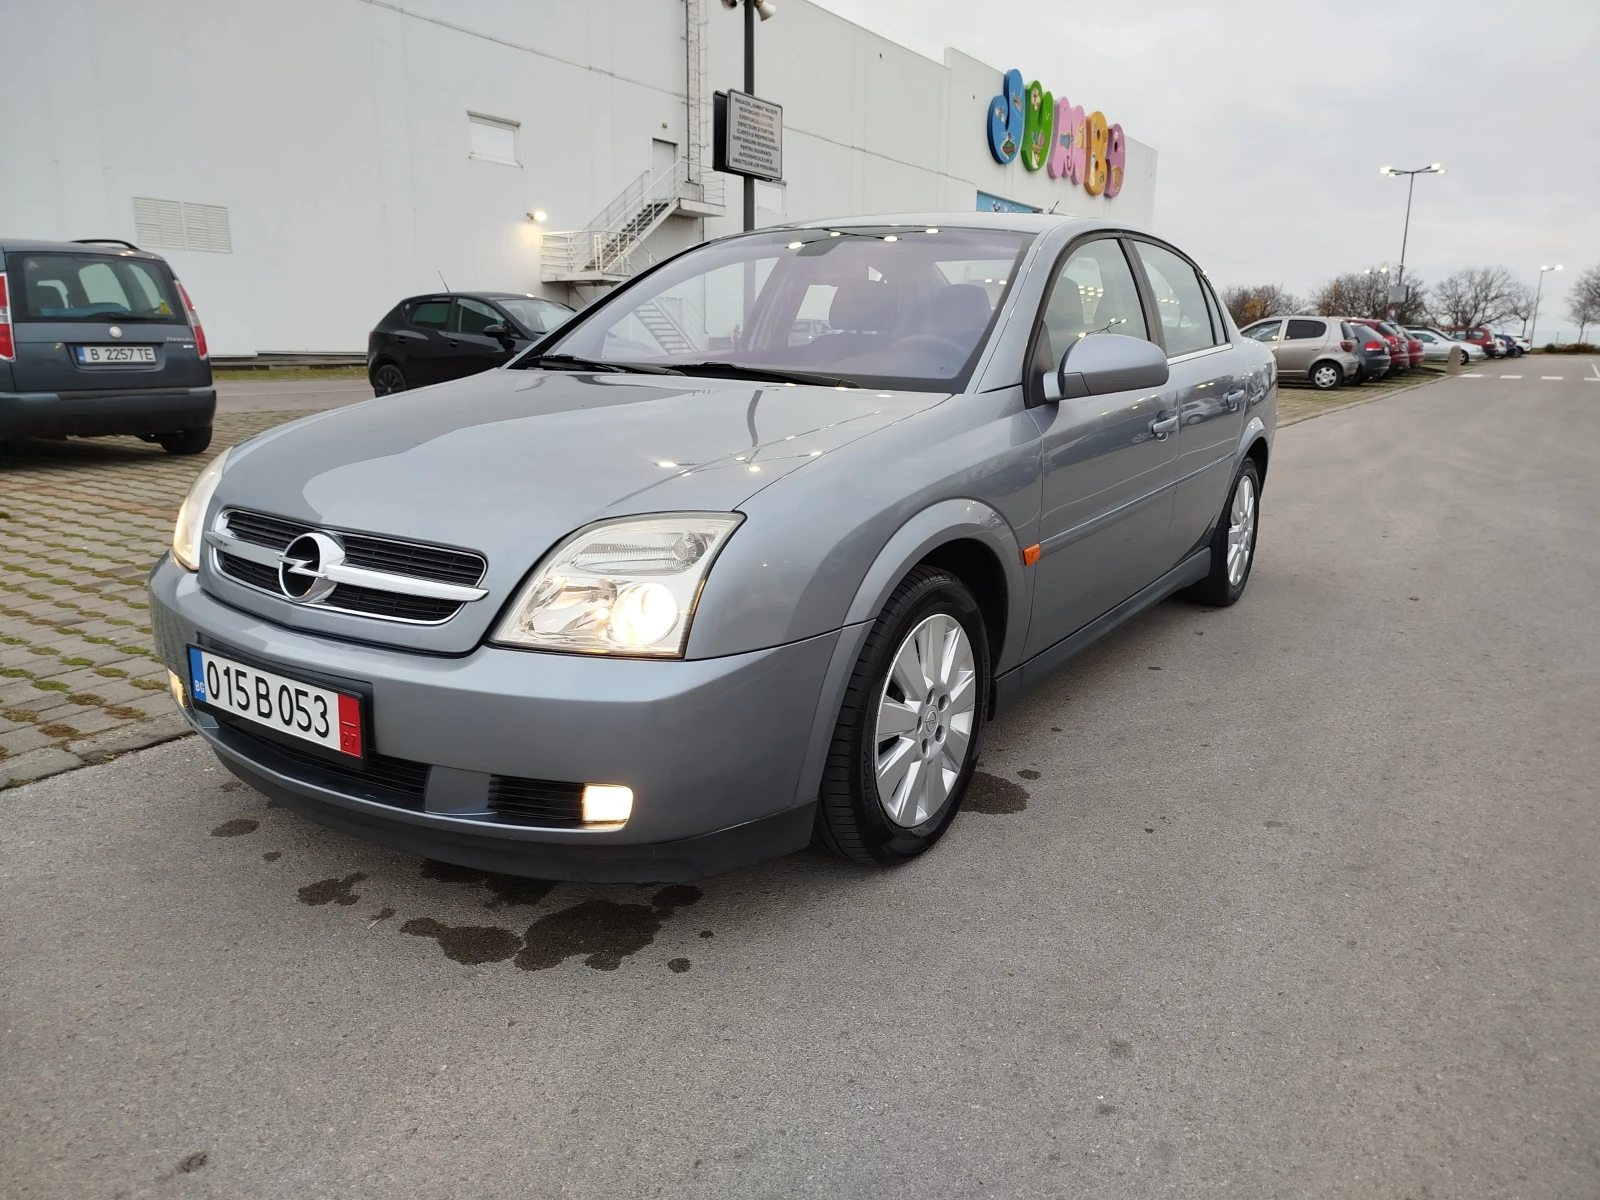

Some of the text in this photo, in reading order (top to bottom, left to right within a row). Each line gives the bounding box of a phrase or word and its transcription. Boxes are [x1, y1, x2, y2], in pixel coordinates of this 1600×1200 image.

[987, 68, 1126, 198] JUMBO
[90, 348, 100, 360] B
[105, 348, 134, 360] 2257
[136, 348, 153, 360] TE
[194, 680, 205, 694] BG
[343, 731, 356, 748] 27
